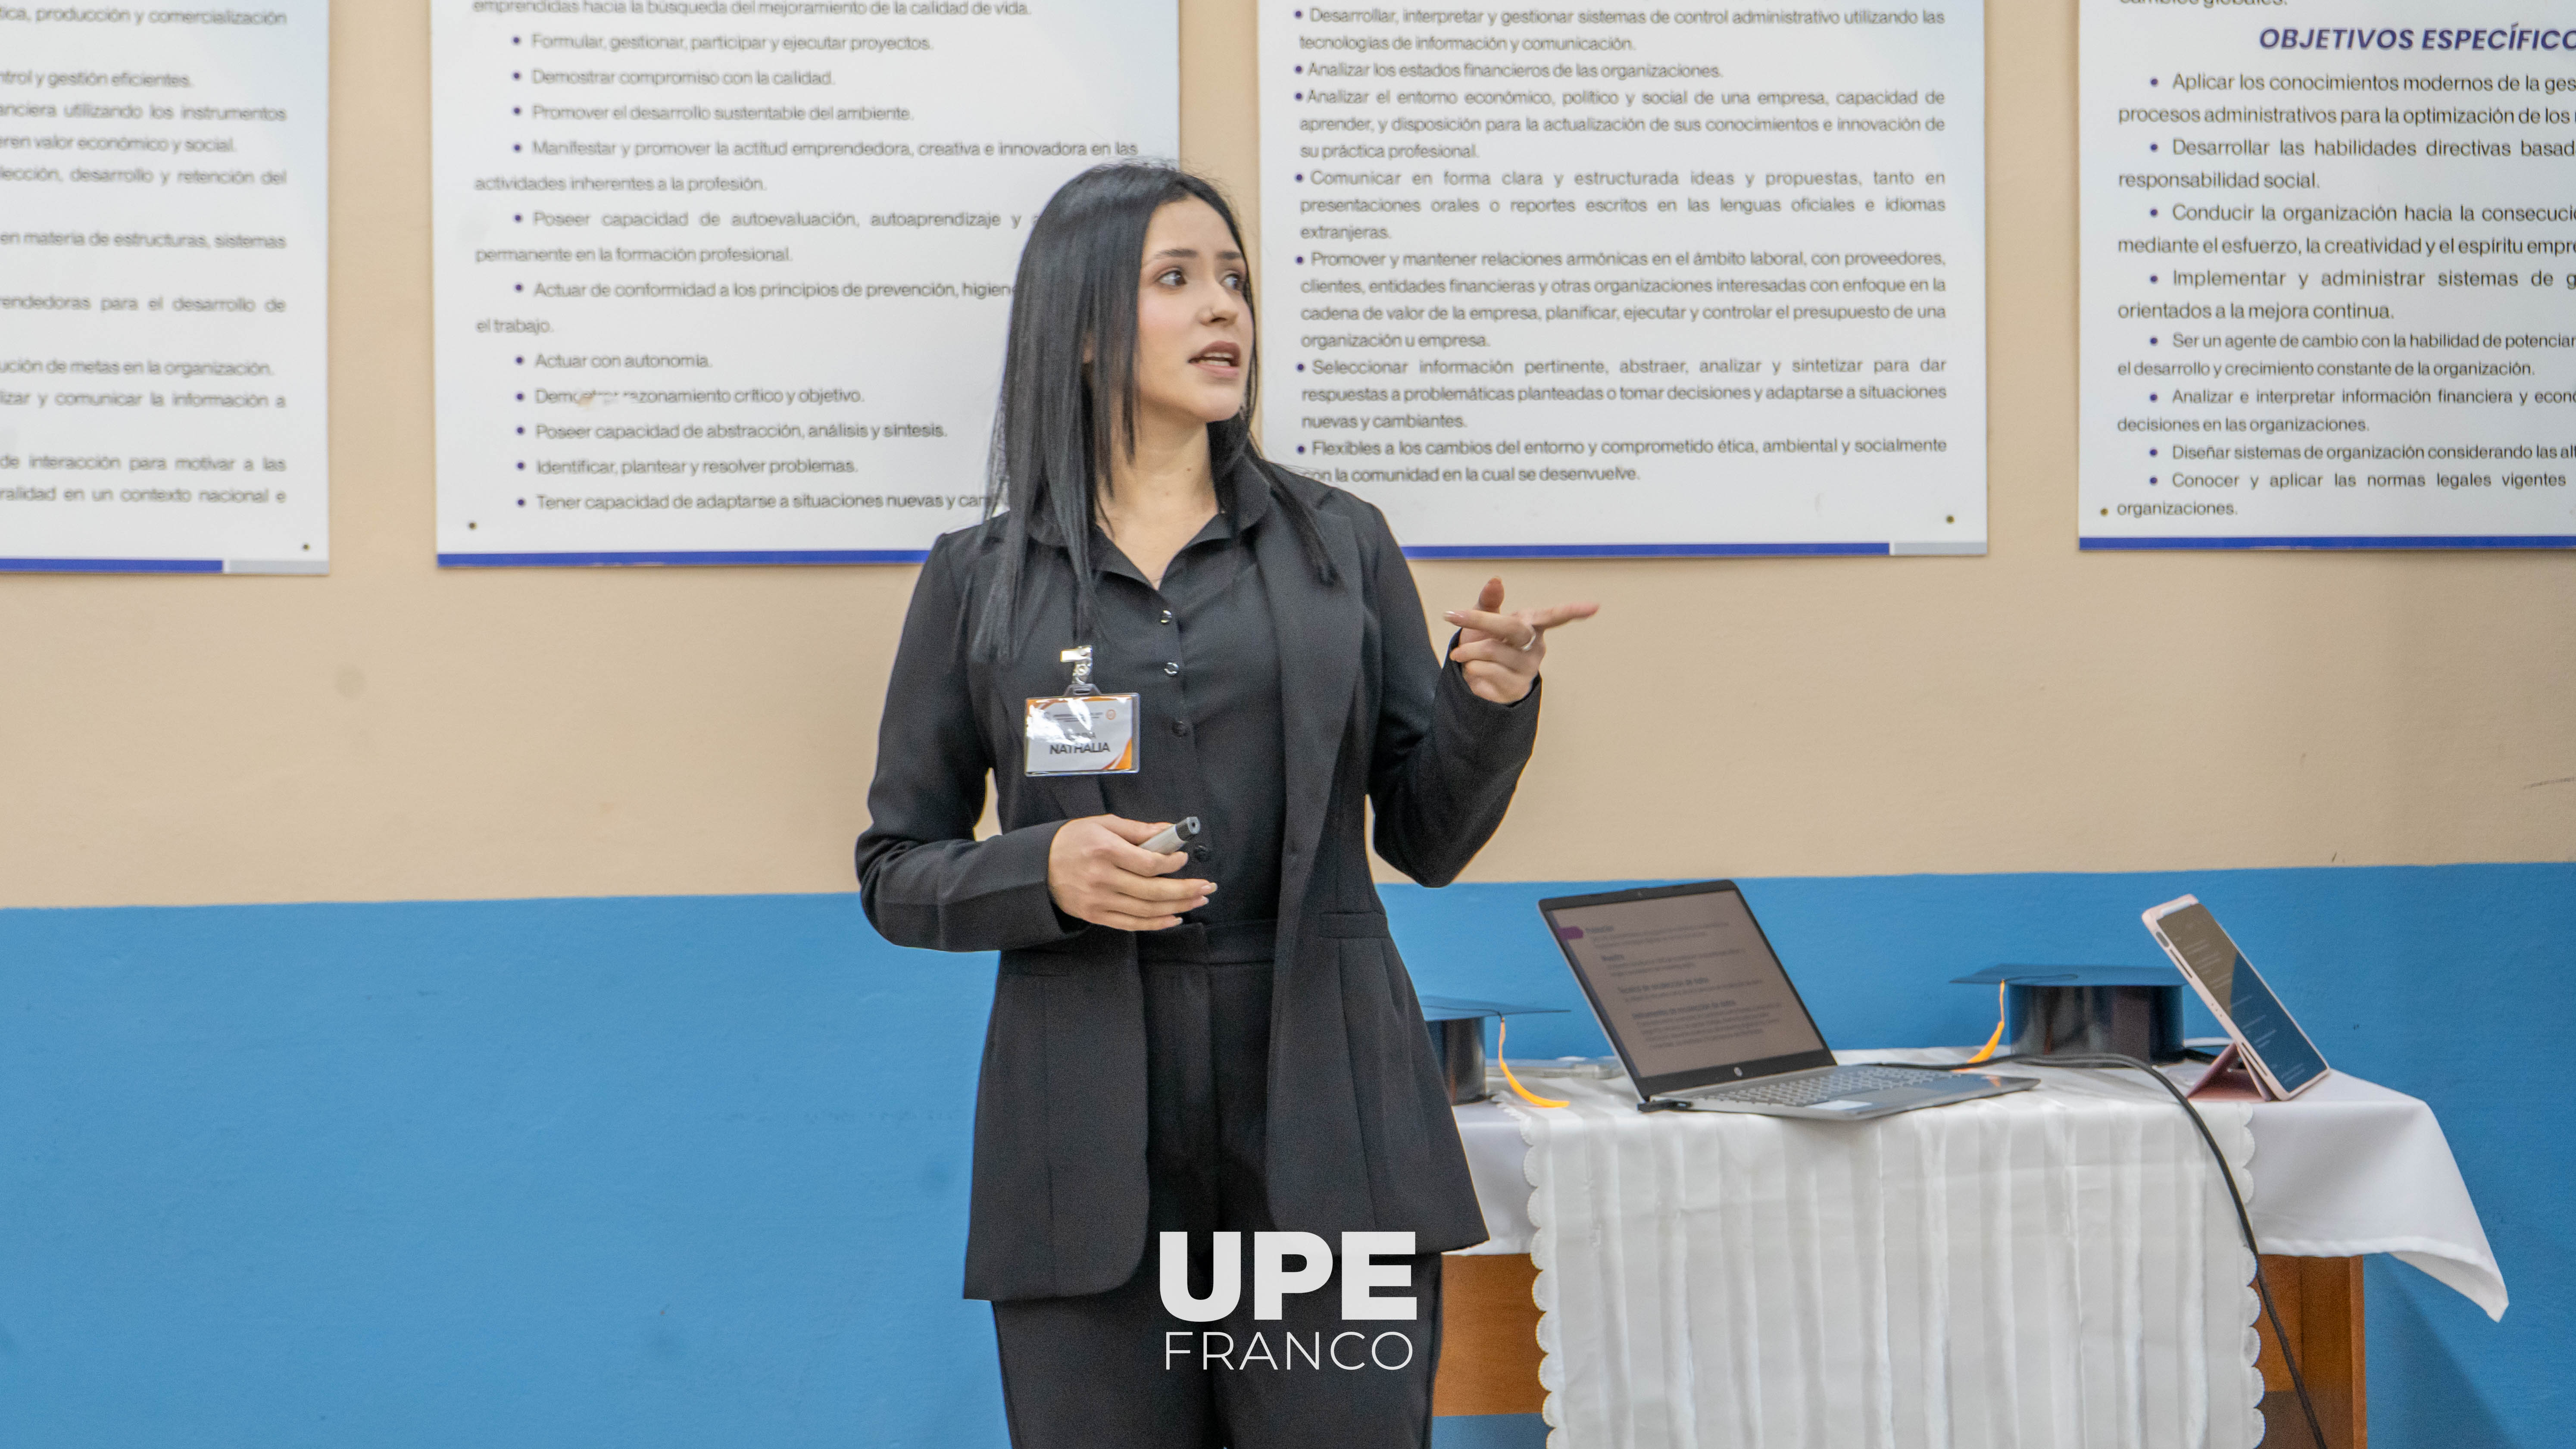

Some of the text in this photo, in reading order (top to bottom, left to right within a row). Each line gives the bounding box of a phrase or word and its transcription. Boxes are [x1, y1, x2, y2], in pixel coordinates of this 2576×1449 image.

[2259, 27, 2414, 50] OBJETIVOS
[2172, 72, 2540, 92] Aplicar los conocimientos modernos de la
[2118, 106, 2570, 126] procesos administrativos para la optimización de los
[2173, 138, 2511, 156] Desarrollar las habilidades directivas
[1310, 169, 1945, 187] Comunicar en forma clara y estructurada ideas y propuestas, tanto en
[2118, 172, 2320, 190] responsabilidad social.
[533, 211, 1021, 229] Poseer capacidad de autoevaluación, autoaprendizaje y
[2172, 203, 2475, 225] Conducir la organización hacia la
[1300, 225, 1392, 241] extranjeras.
[2118, 237, 2523, 257] mediante el esfuerzo, la creatividad y el espíritu
[2173, 270, 2286, 288] Implementar
[2298, 274, 2308, 289] y
[2321, 270, 2425, 286] administrar
[2438, 270, 2518, 287] sistemas
[2530, 270, 2554, 287] de
[2117, 302, 2395, 322] orientados a la mejora continua.
[2173, 332, 2199, 347] Ser
[2203, 337, 2221, 347] un
[2225, 334, 2276, 350] agente
[2279, 334, 2299, 347] de
[2302, 334, 2358, 347] cambio
[2361, 336, 2390, 347] con
[2394, 334, 2406, 348] la
[2410, 333, 2479, 348] habilidad
[2482, 333, 2502, 347] de
[534, 353, 713, 368] Actuar con autonomía.
[1312, 358, 1946, 375] Seleccionar información pertinente, abstraer, analizar y sintetizar para dar
[2117, 361, 2535, 378] el desarrollo y crecimiento constante de la organización.
[2172, 388, 2528, 406] Analizar e interpretar información financiera y
[1302, 414, 1468, 430] nuevas y cambiantes.
[2117, 417, 2370, 434] decisiones en las organizaciones.
[2172, 444, 2557, 462] Diseñar sistemas de organización considerando las
[536, 459, 858, 476] Identificar, plantear y resolver problemas.
[2172, 472, 2566, 490] Conocer y aplicar las normas legales vigentes
[537, 493, 955, 511] Tener capacidad de adaptarse a situaciones nuevas y
[2117, 502, 2238, 518] organizaciones.
[1049, 742, 1110, 754] NATHALIA
